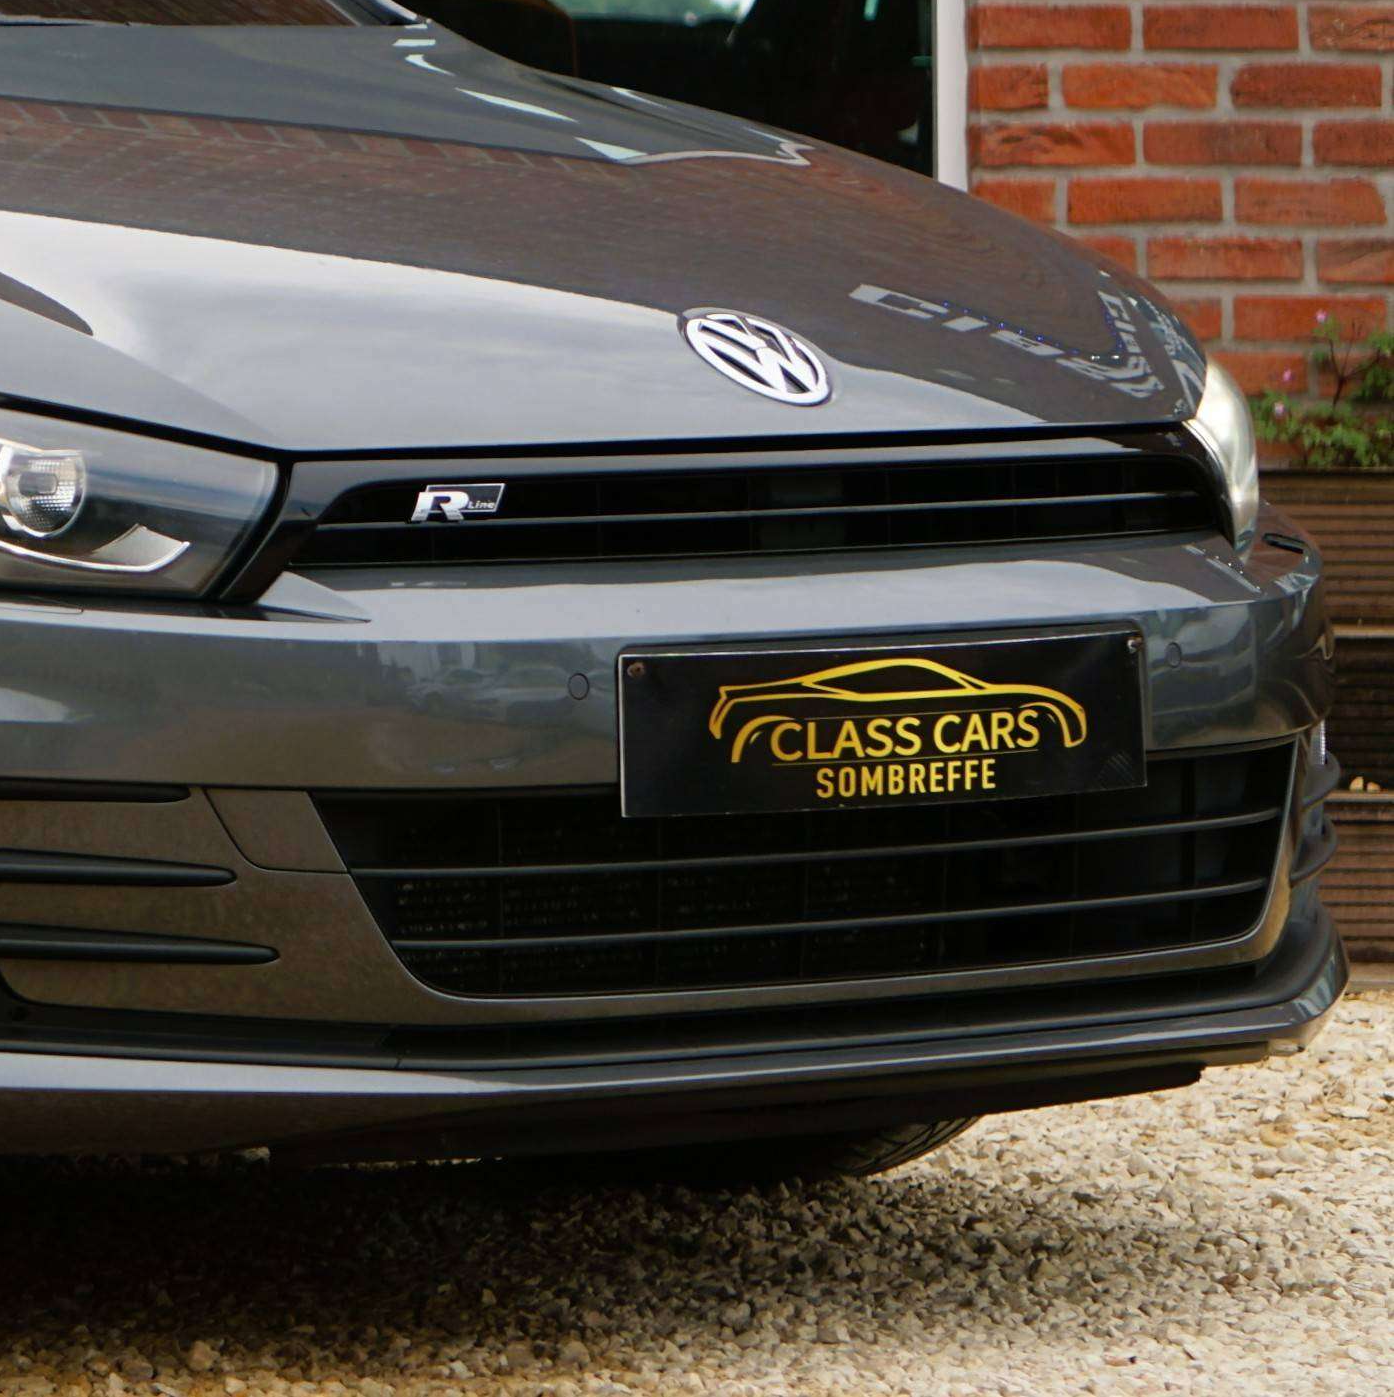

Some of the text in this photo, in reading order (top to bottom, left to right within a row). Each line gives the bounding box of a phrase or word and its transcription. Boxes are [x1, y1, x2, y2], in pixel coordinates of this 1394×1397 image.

[411, 491, 469, 522] R
[770, 707, 1041, 762] CLASS CARS
[815, 758, 997, 799] SOMBREFFE
